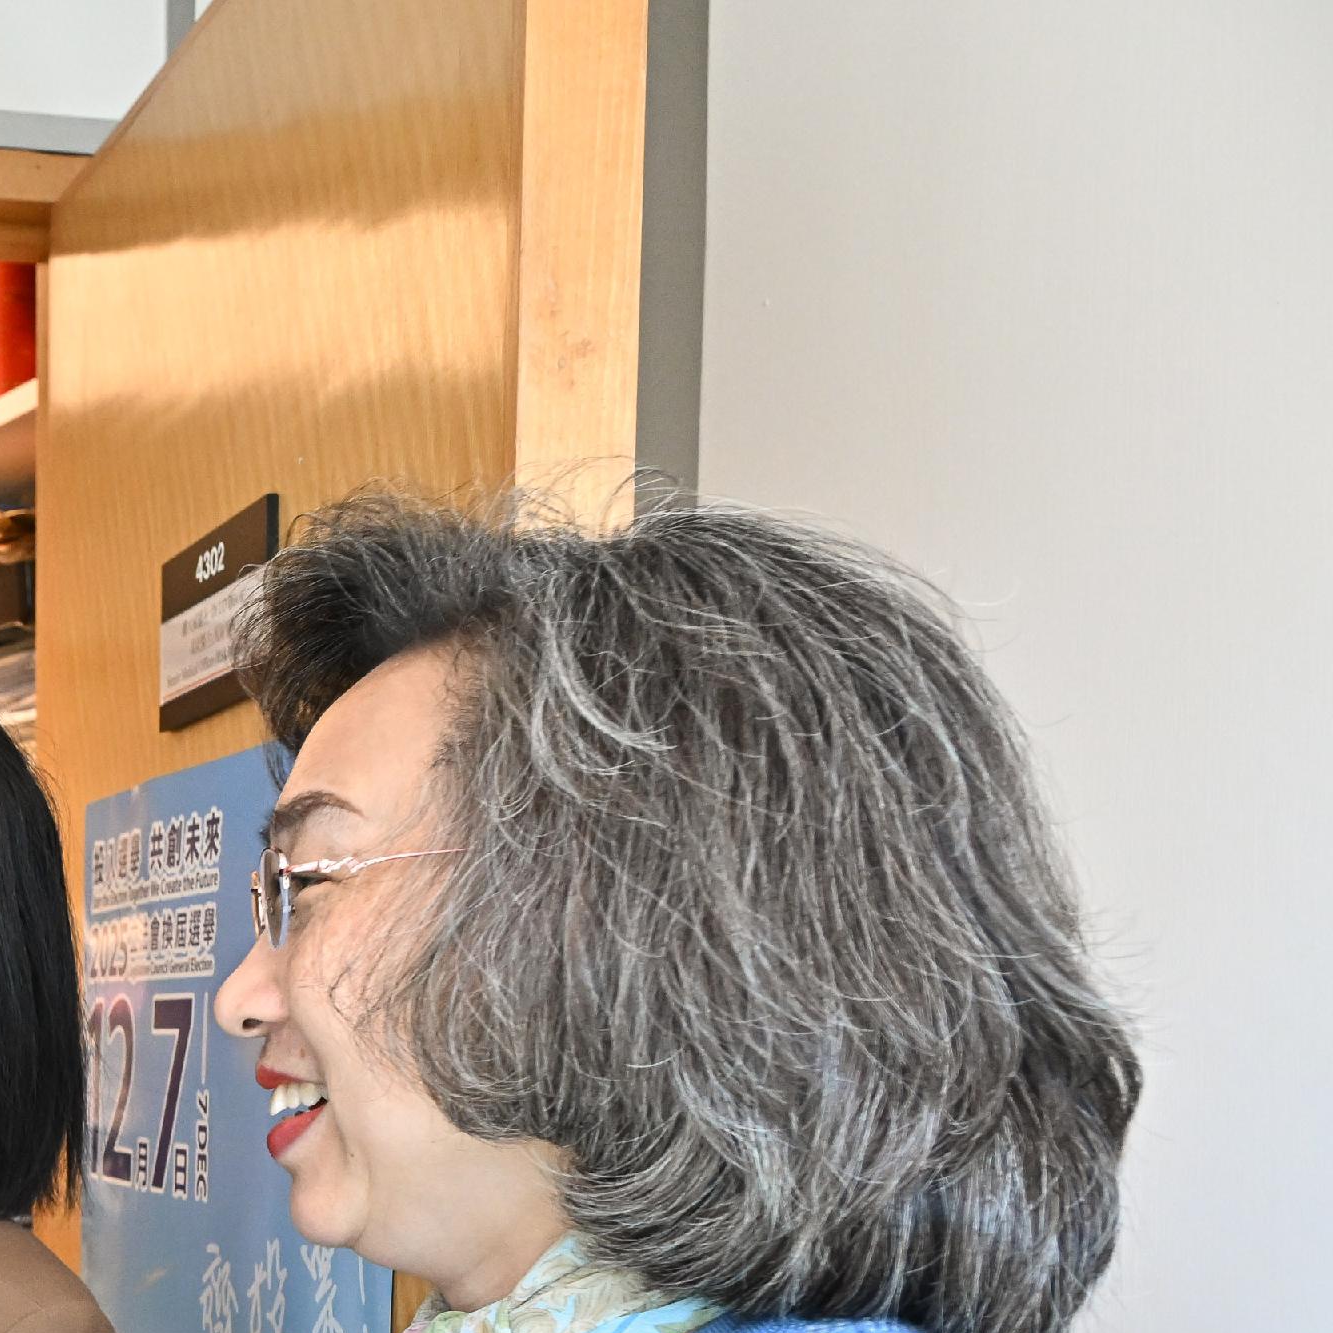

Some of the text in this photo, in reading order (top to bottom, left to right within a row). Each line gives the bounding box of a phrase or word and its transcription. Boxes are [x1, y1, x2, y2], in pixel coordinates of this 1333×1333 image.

[195, 541, 225, 583] 4302
[150, 812, 220, 870] 共創未來
[161, 878, 182, 894] Create
[183, 875, 194, 890] the
[196, 872, 218, 888] Future
[196, 1124, 208, 1198] DEC
